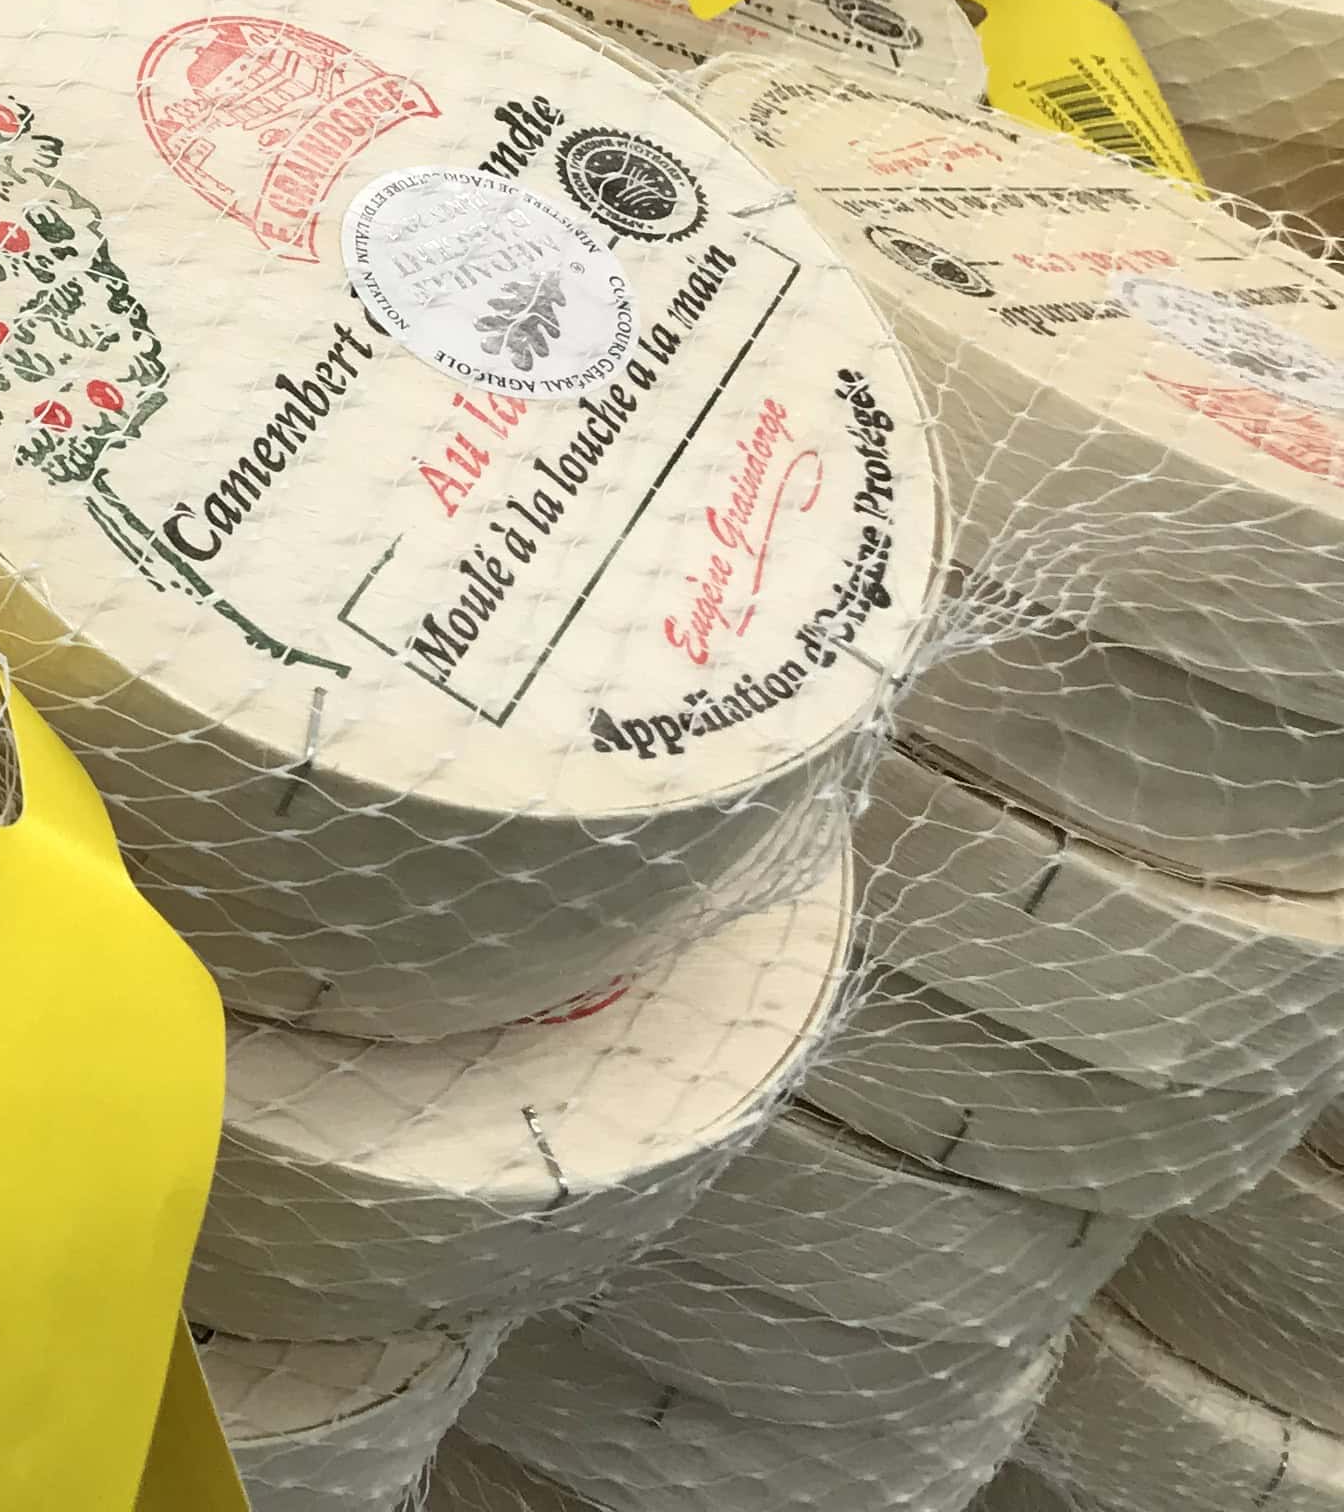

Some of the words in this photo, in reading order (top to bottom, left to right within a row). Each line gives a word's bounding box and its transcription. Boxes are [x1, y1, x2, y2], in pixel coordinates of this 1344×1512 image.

[669, 244, 739, 332] main
[636, 324, 681, 369] la
[163, 320, 373, 563] Camembert
[412, 429, 491, 518] Au
[533, 380, 639, 498] louche
[834, 368, 895, 525] Protégée
[489, 518, 538, 564] à
[505, 491, 565, 537] la
[665, 554, 734, 666] Eugène
[706, 399, 794, 557] Graindorge
[406, 544, 516, 684] Moulé
